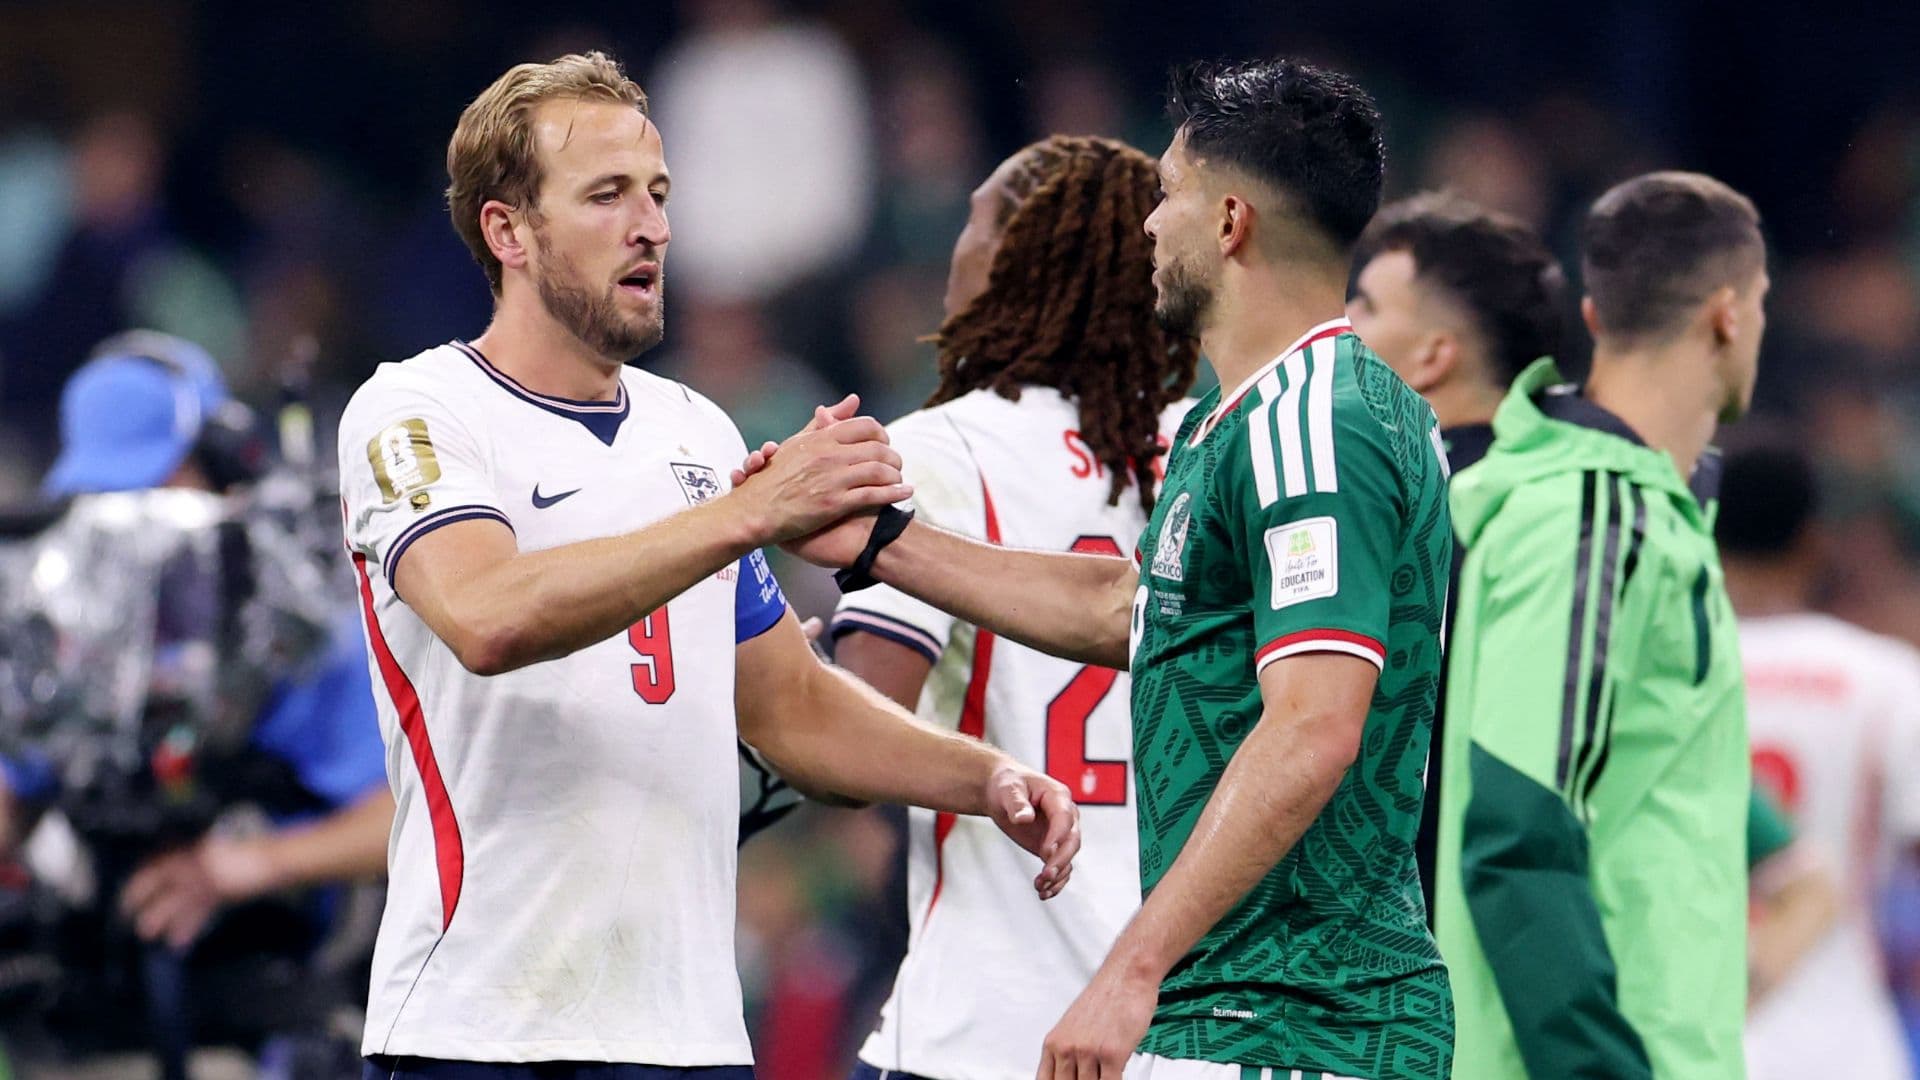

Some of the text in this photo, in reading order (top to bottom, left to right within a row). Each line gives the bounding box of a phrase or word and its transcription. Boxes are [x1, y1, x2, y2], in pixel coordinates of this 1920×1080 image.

[1152, 560, 1182, 579] MEXICO
[1280, 568, 1325, 590] EDUCATION
[627, 602, 676, 705] 9
